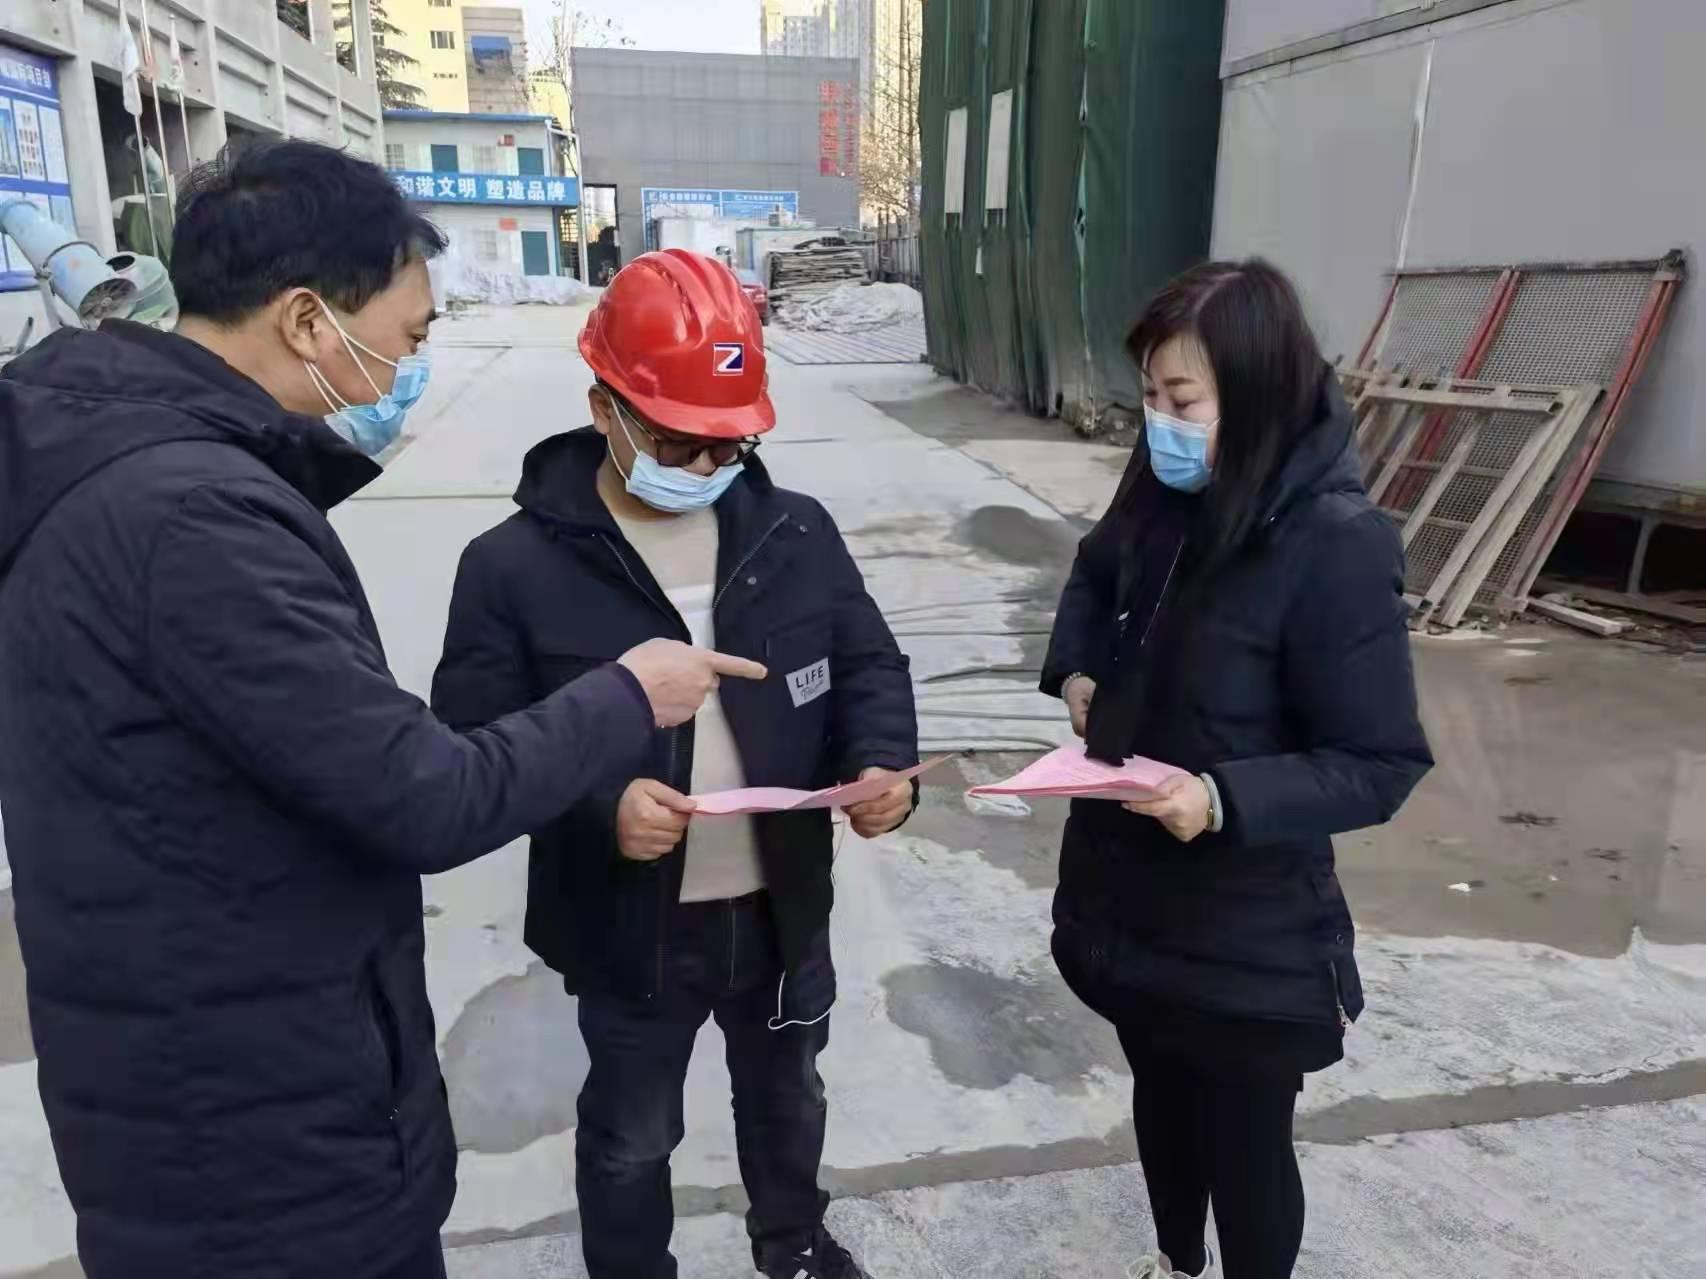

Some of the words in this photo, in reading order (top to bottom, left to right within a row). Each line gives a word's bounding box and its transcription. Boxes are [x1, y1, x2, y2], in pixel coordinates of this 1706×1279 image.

[395, 175, 477, 198] 和谐文明
[486, 179, 566, 201] 塑造品牌
[796, 665, 824, 688] LIFE
